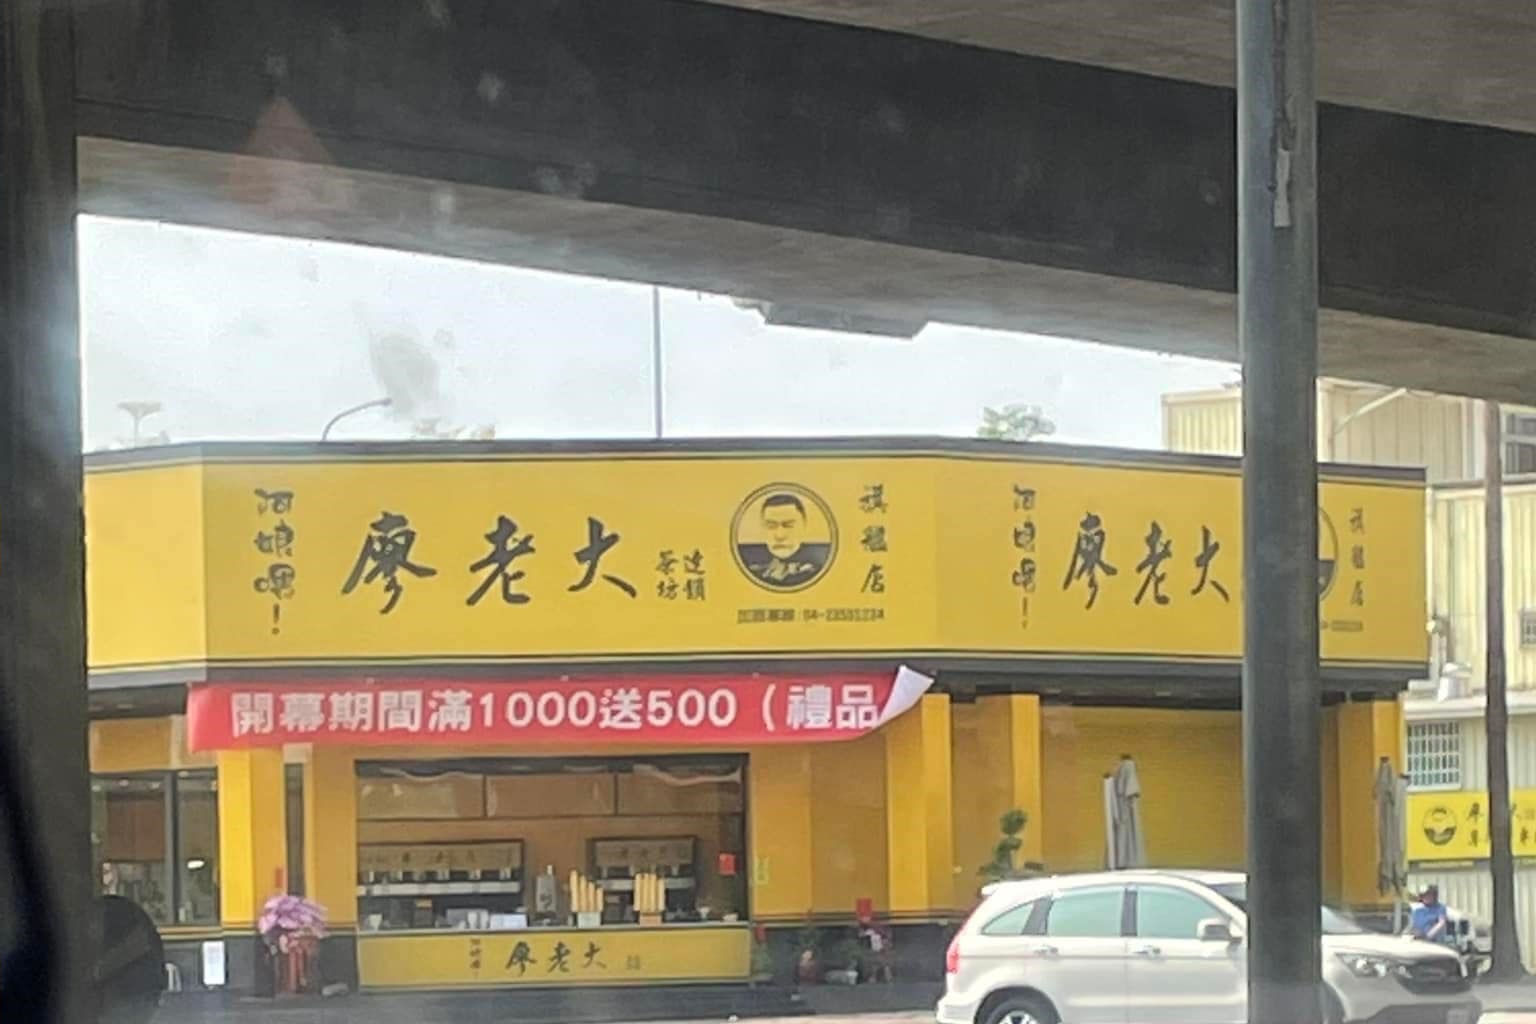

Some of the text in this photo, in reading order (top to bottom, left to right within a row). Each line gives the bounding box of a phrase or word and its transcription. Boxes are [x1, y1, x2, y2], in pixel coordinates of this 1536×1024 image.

[342, 511, 637, 615] 廖老大
[1063, 511, 1230, 610] 廖老大
[505, 941, 606, 976] 廖老大
